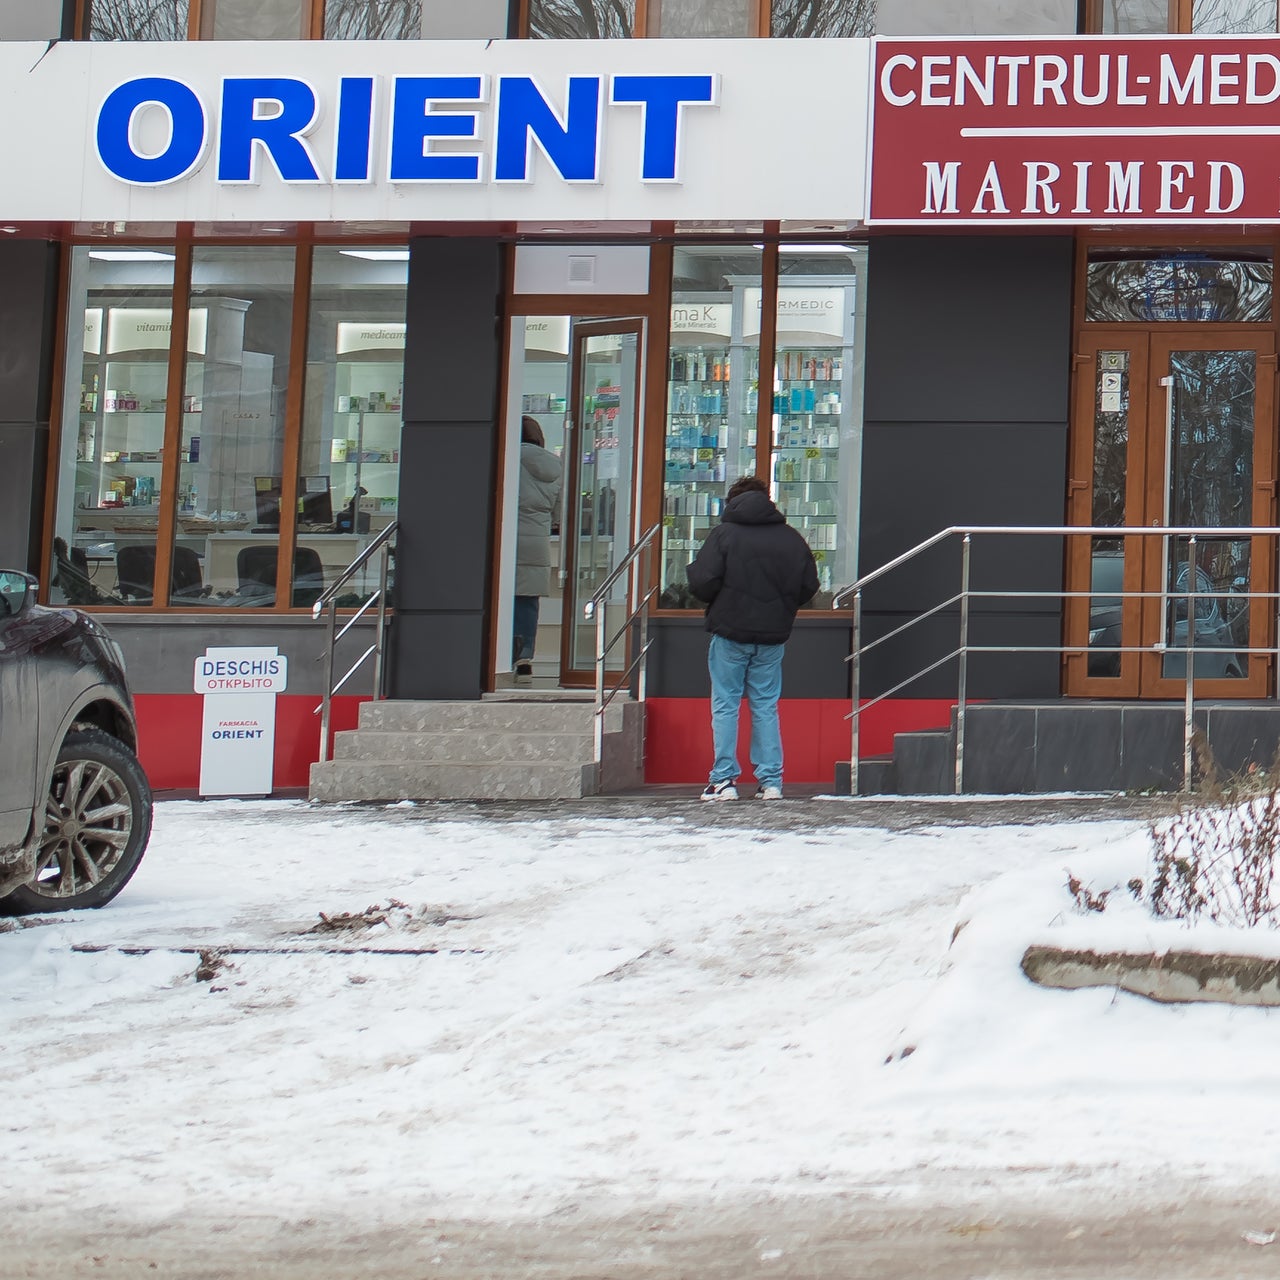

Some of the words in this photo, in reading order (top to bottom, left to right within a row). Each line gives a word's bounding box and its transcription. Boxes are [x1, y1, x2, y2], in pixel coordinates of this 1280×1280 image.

[94, 74, 722, 186] ORIENT
[920, 161, 1246, 214] MARIMED
[203, 660, 279, 675] DESCHIS
[208, 678, 272, 688] ОТКРЫТО
[212, 730, 264, 740] ORIENT
